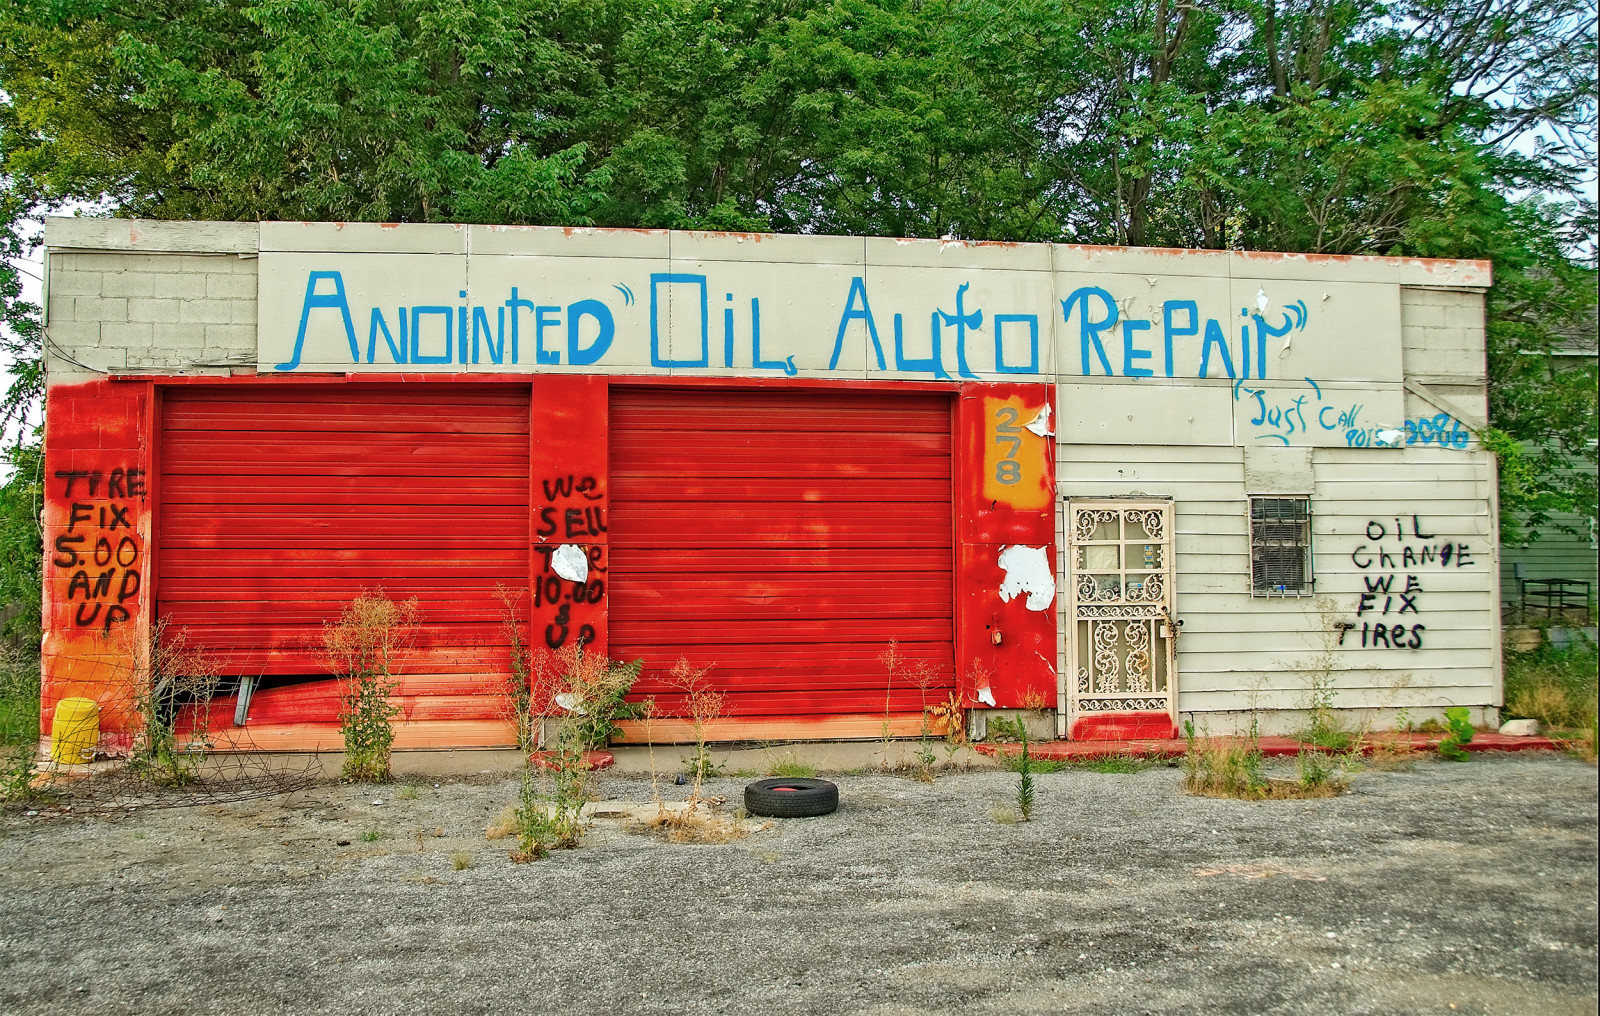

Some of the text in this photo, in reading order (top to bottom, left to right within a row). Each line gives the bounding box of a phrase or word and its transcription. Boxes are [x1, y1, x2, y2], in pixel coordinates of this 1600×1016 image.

[996, 407, 1022, 485] 278
[68, 503, 130, 533] FIX
[68, 568, 141, 604] AND
[1364, 574, 1423, 594] WE
[76, 603, 130, 638] UP
[1357, 593, 1418, 617] FIX
